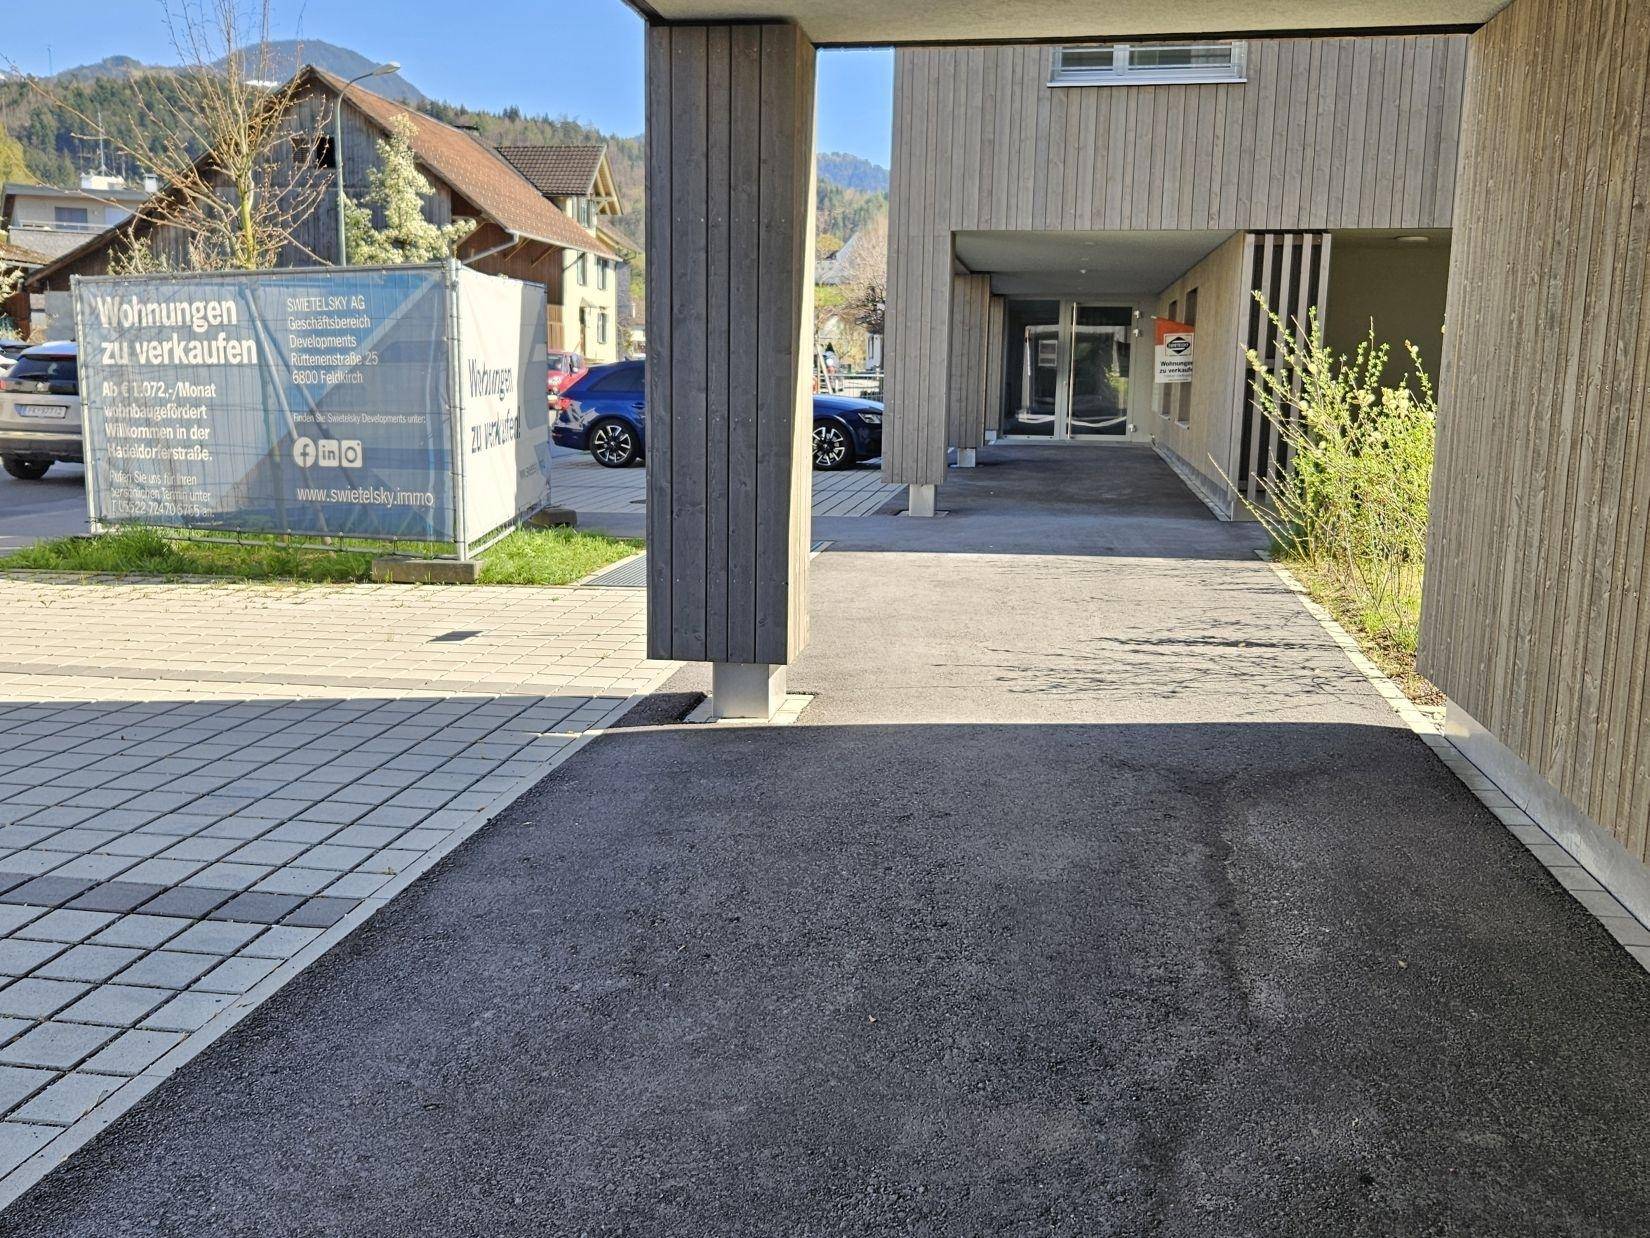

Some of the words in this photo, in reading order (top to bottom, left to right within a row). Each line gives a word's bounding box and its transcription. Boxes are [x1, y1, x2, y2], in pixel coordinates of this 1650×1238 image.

[287, 296, 348, 311] SWIETELSKY
[351, 295, 365, 310] AG
[96, 295, 237, 333] Wohnungen
[288, 314, 371, 330] Geschäftsbereich
[101, 341, 129, 365] zu
[135, 332, 258, 365] verkaufen
[289, 334, 357, 349] Developments
[365, 352, 379, 366] 25
[292, 371, 318, 384] 6800
[320, 371, 364, 384] Feldkirch
[468, 358, 513, 401] Wohnungen
[102, 381, 118, 397] Ab
[121, 383, 130, 397] €
[104, 403, 208, 421] wohnbaugefördert
[293, 413, 315, 423] Finden
[327, 413, 361, 425] Swietelsky
[361, 413, 406, 424] Developments
[407, 414, 426, 424] unter:
[105, 422, 174, 438] Willkommen
[176, 424, 187, 439] in
[190, 424, 210, 440] der
[471, 425, 482, 454] zu
[134, 470, 147, 484] Sie
[189, 490, 211, 502] unter
[296, 486, 434, 508] www.swietelsky.immo
[149, 501, 176, 515] 72470
